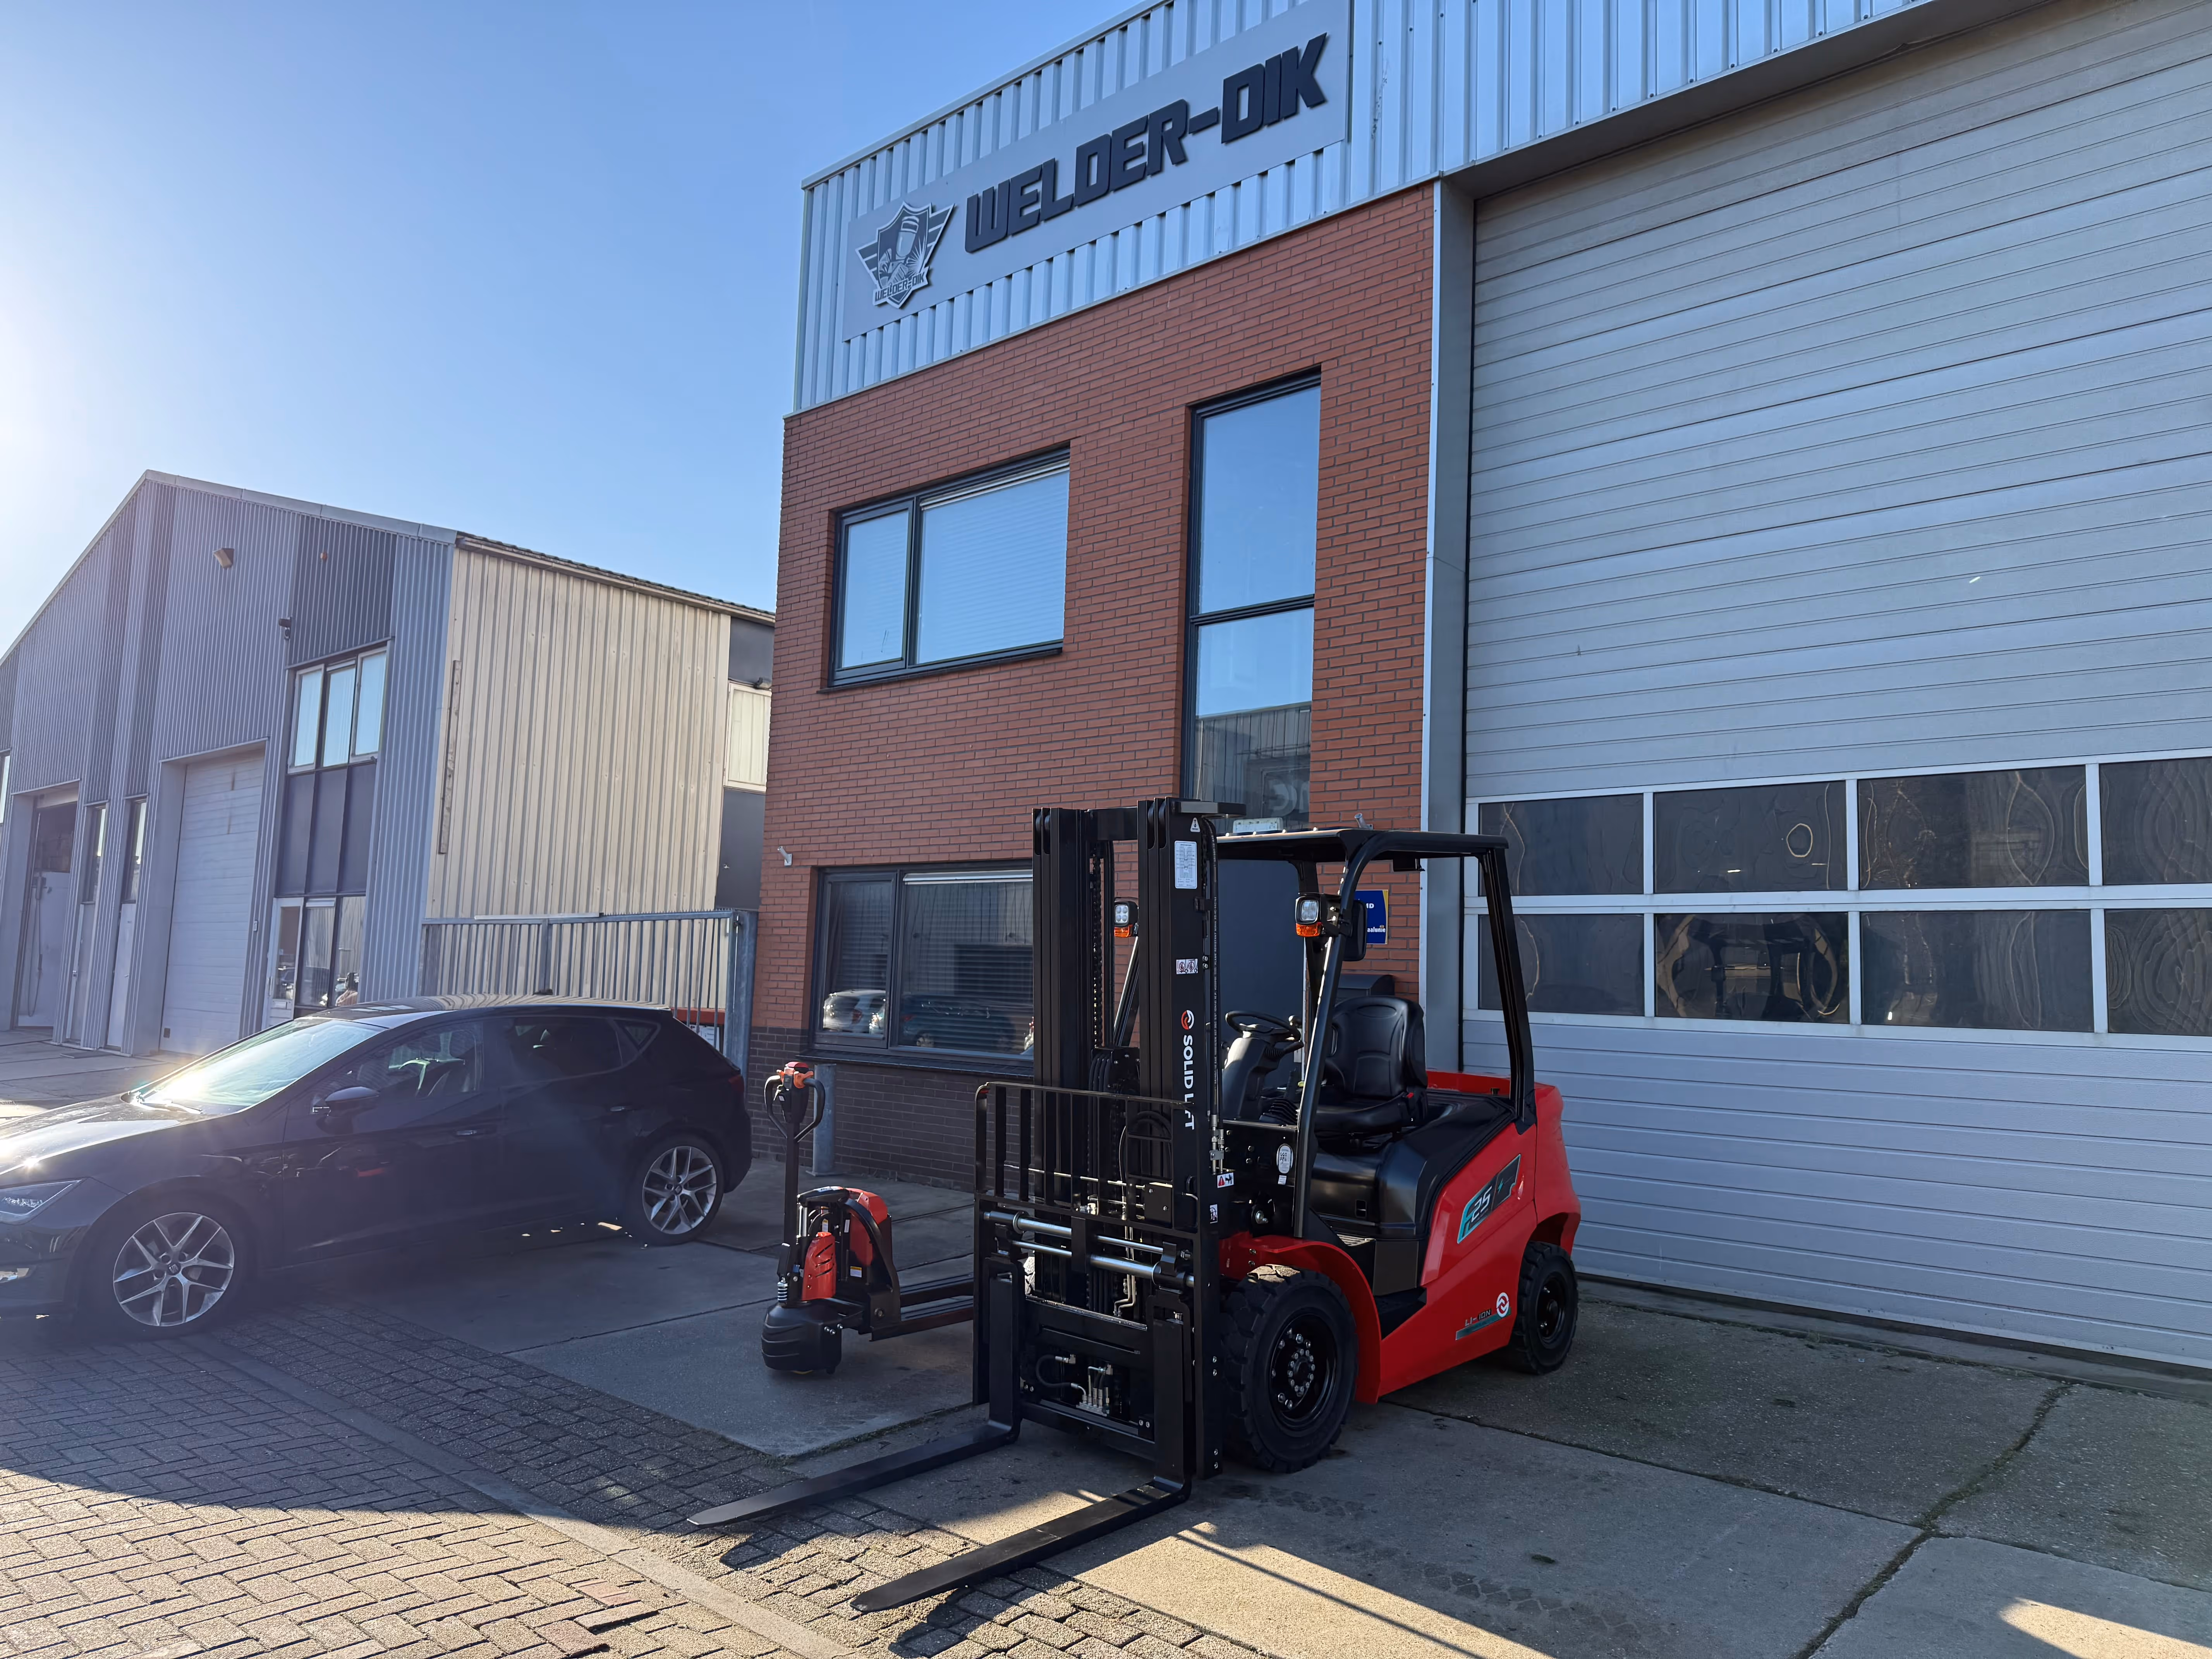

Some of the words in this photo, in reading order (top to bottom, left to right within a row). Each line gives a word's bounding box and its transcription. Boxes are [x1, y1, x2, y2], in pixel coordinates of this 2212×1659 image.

[965, 33, 1328, 253] WELDER-DIK
[1183, 1035, 1193, 1089] SOLID
[1185, 1093, 1194, 1130] LFT
